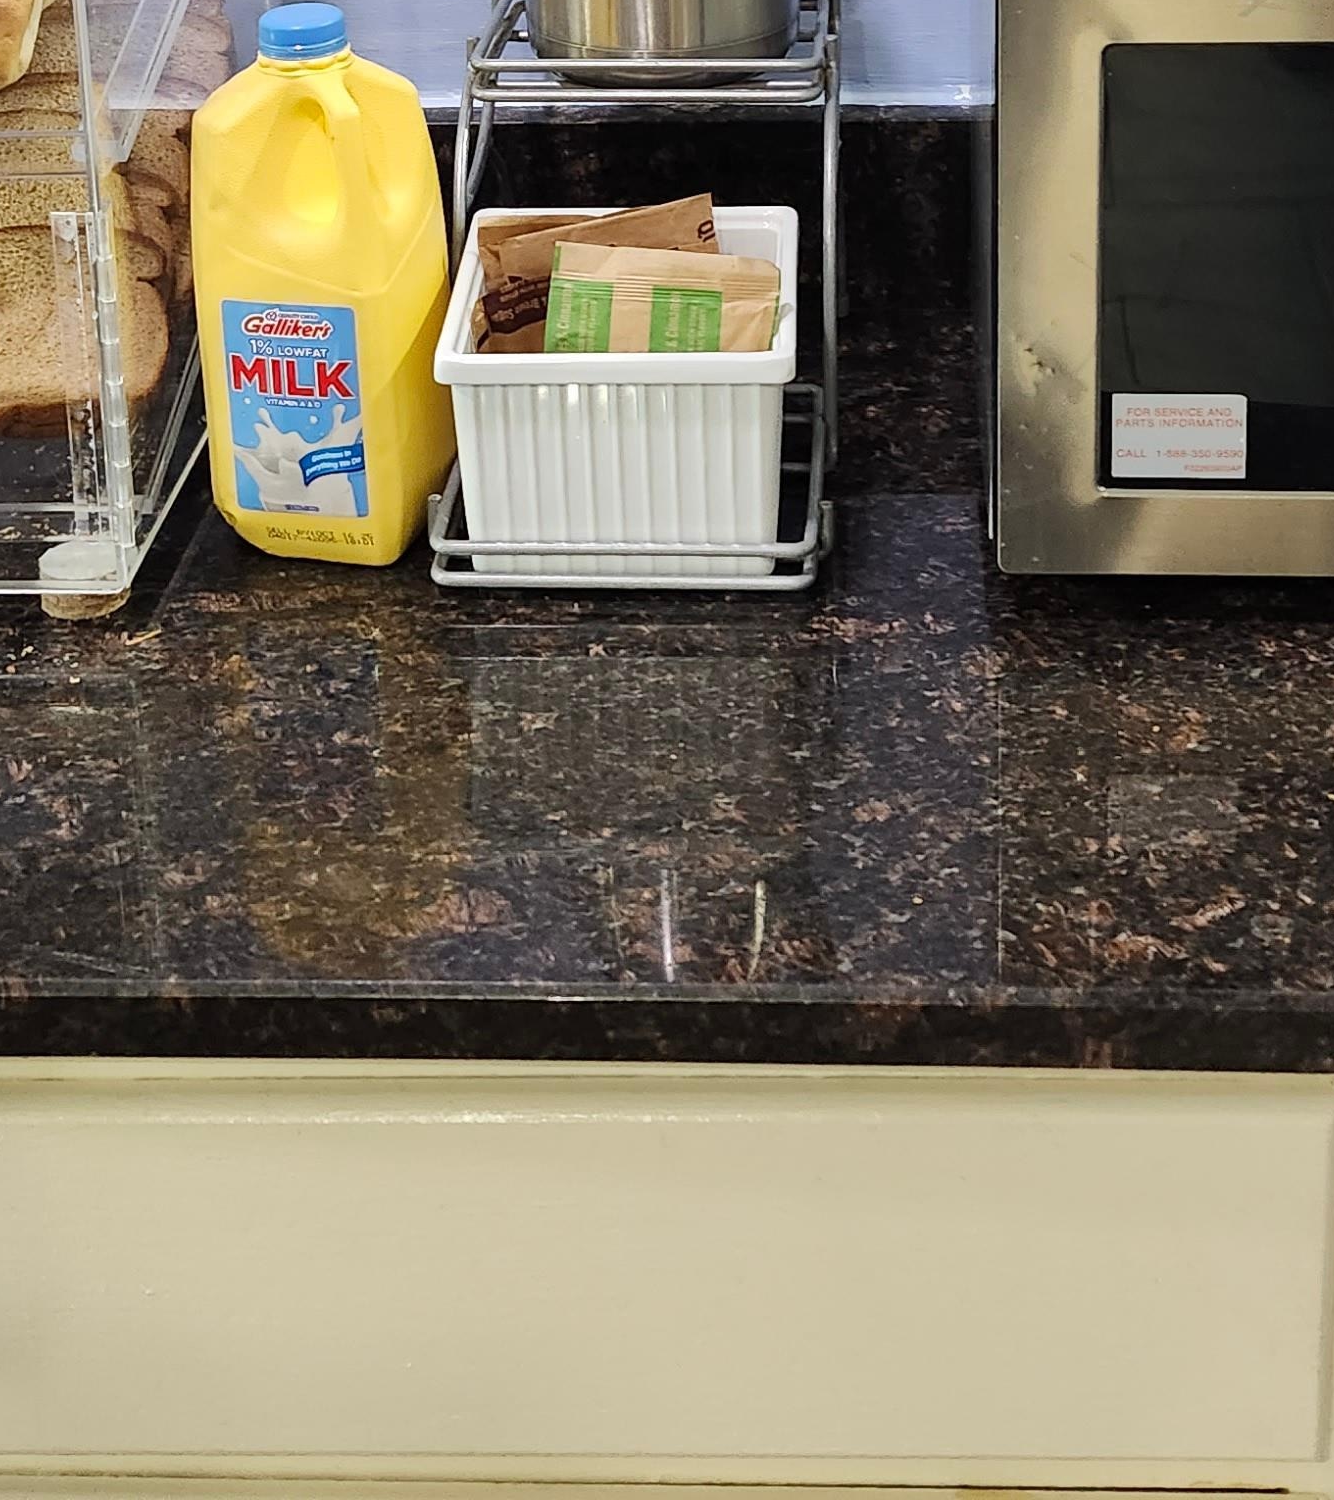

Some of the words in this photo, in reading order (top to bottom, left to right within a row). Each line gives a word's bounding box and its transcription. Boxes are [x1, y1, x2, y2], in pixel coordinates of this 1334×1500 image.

[244, 315, 332, 338] Galliker's
[249, 339, 273, 356] 1%
[278, 346, 328, 358] LOWFAT
[231, 355, 354, 398] MILK
[1127, 407, 1151, 417] FOR
[1154, 407, 1204, 417] SERVICE
[1207, 407, 1232, 417] AND
[1115, 418, 1155, 428] PARTS
[1159, 418, 1243, 428] INFORMATION
[1116, 448, 1147, 458] CALL
